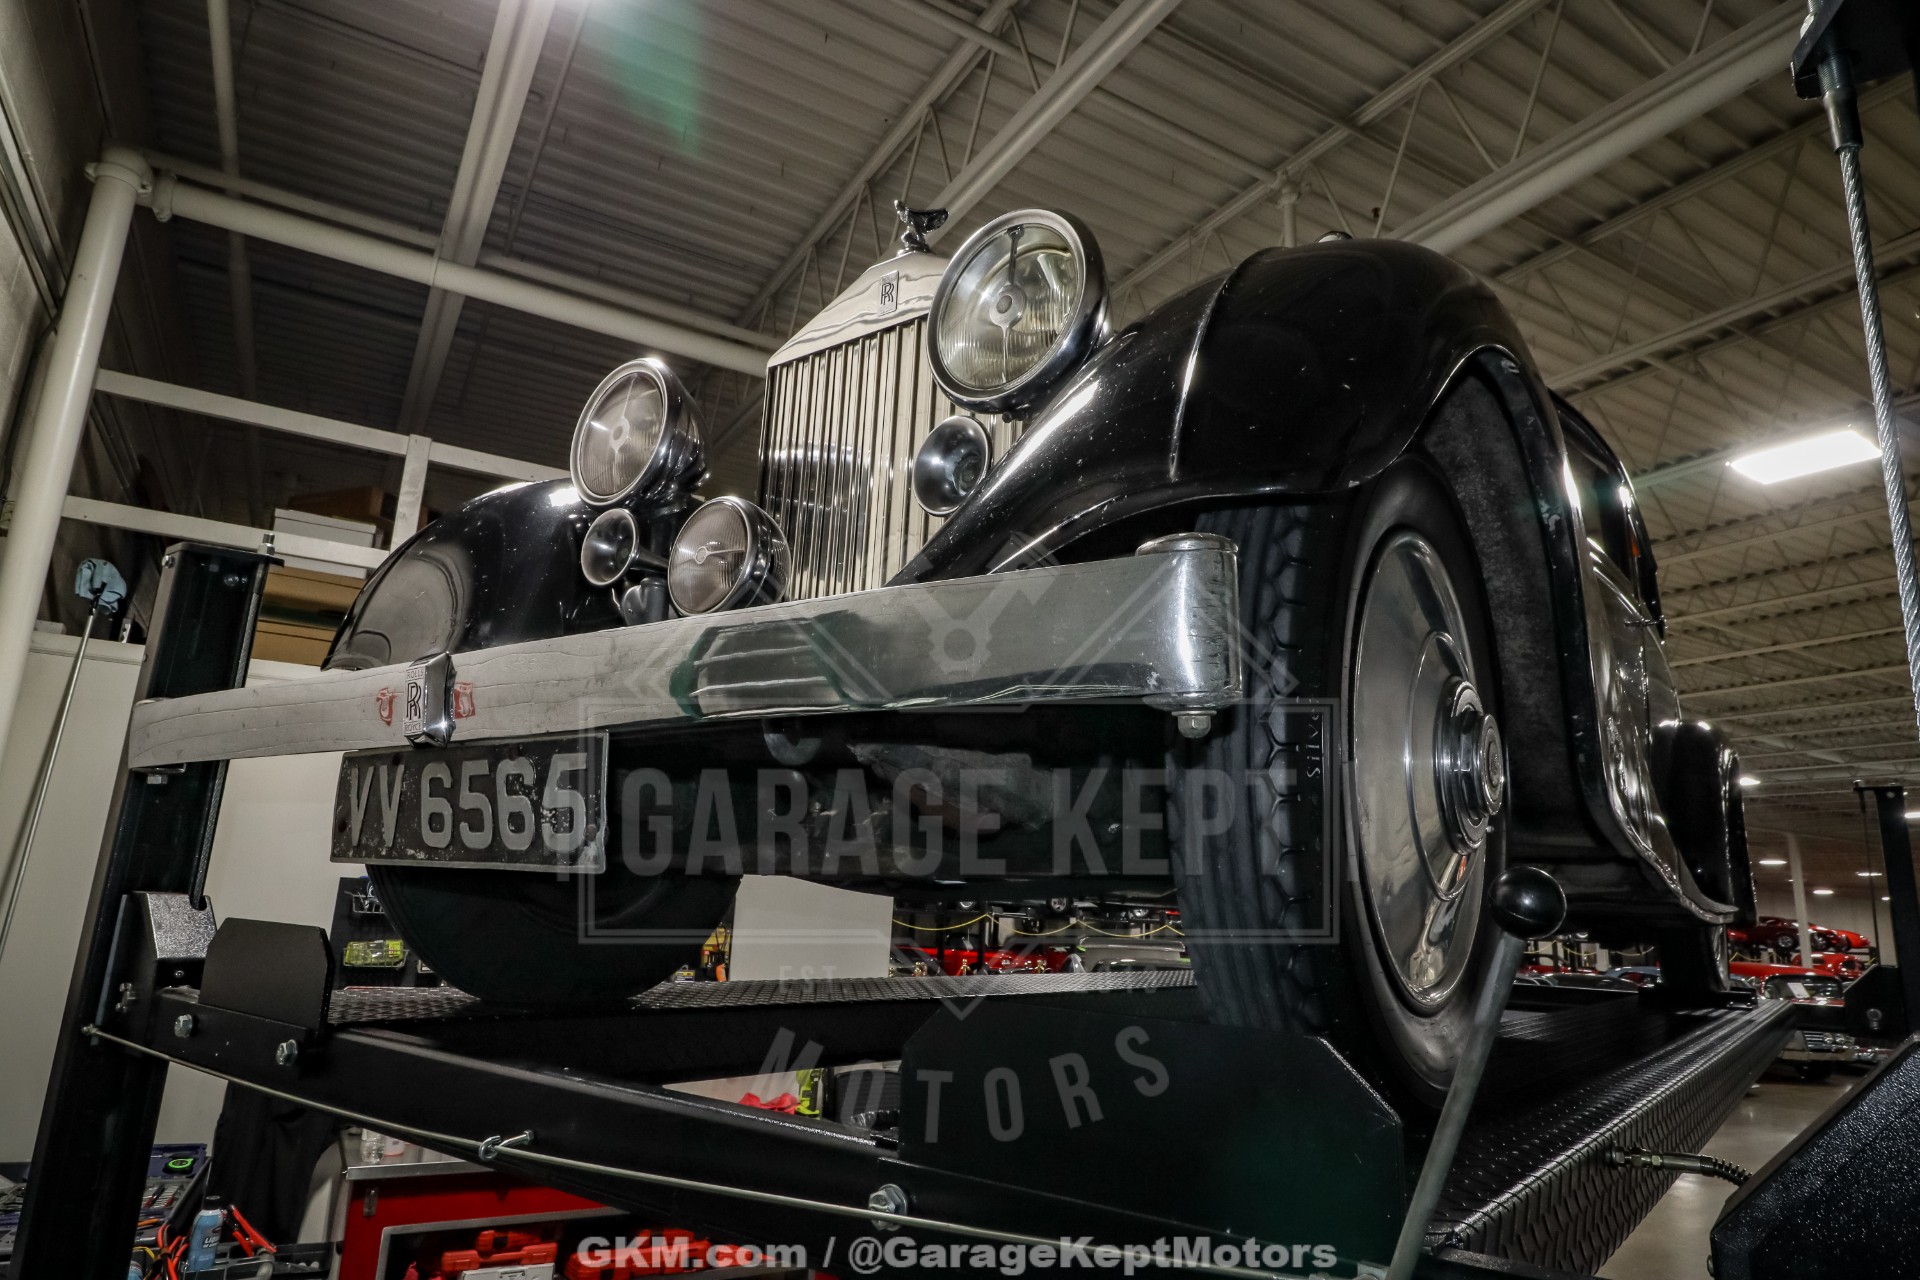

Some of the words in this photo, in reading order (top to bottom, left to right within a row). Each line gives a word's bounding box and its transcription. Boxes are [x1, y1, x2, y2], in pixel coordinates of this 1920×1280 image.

[407, 669, 424, 678] ROLLS
[404, 723, 421, 732] ROYCE
[350, 763, 405, 848] VV
[420, 752, 588, 851] 6565
